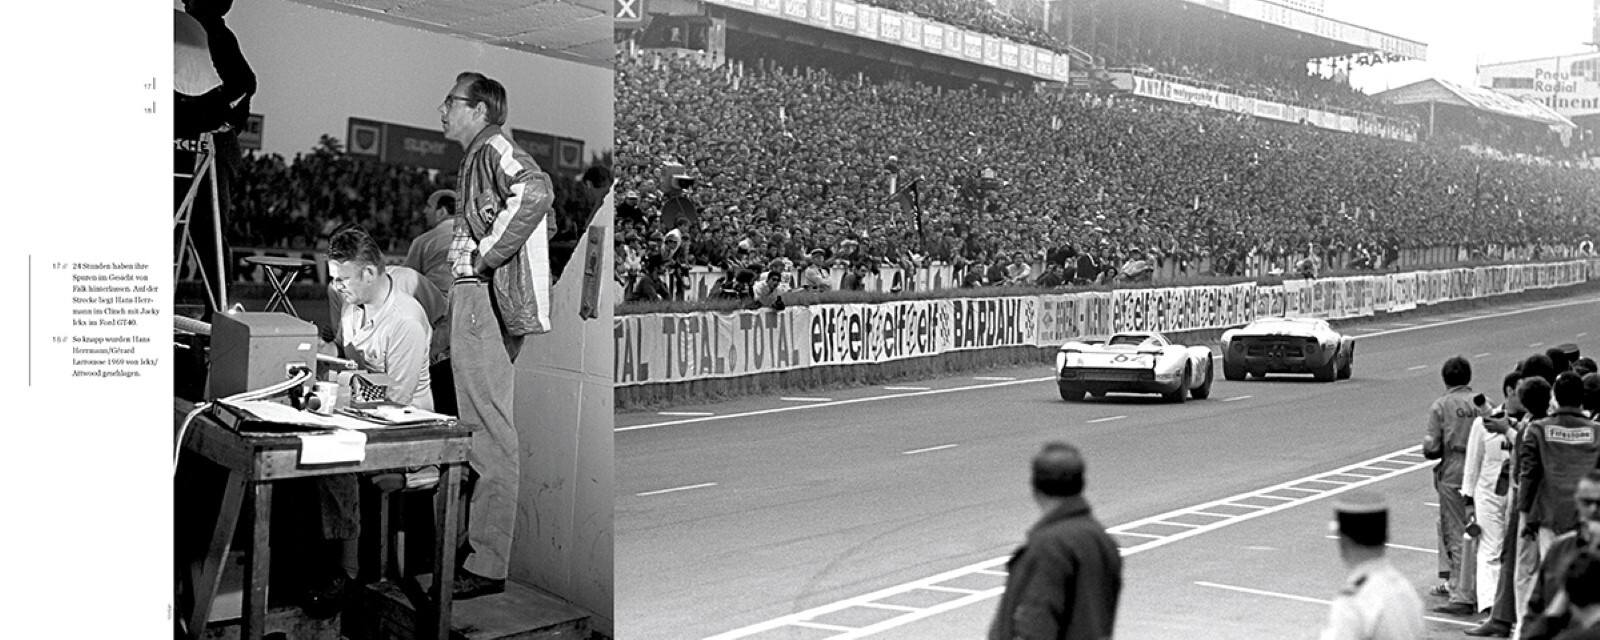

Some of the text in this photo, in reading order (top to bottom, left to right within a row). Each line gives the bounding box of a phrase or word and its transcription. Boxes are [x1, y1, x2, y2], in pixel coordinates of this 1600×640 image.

[1535, 68, 1569, 81] Pneu
[1535, 81, 1577, 93] Radial
[662, 315, 725, 379] TOTAL
[740, 311, 799, 372] TOTAL
[811, 303, 938, 363] elf elf elf elf
[953, 299, 1023, 349] BARDAHL
[1455, 407, 1479, 418] Gul
